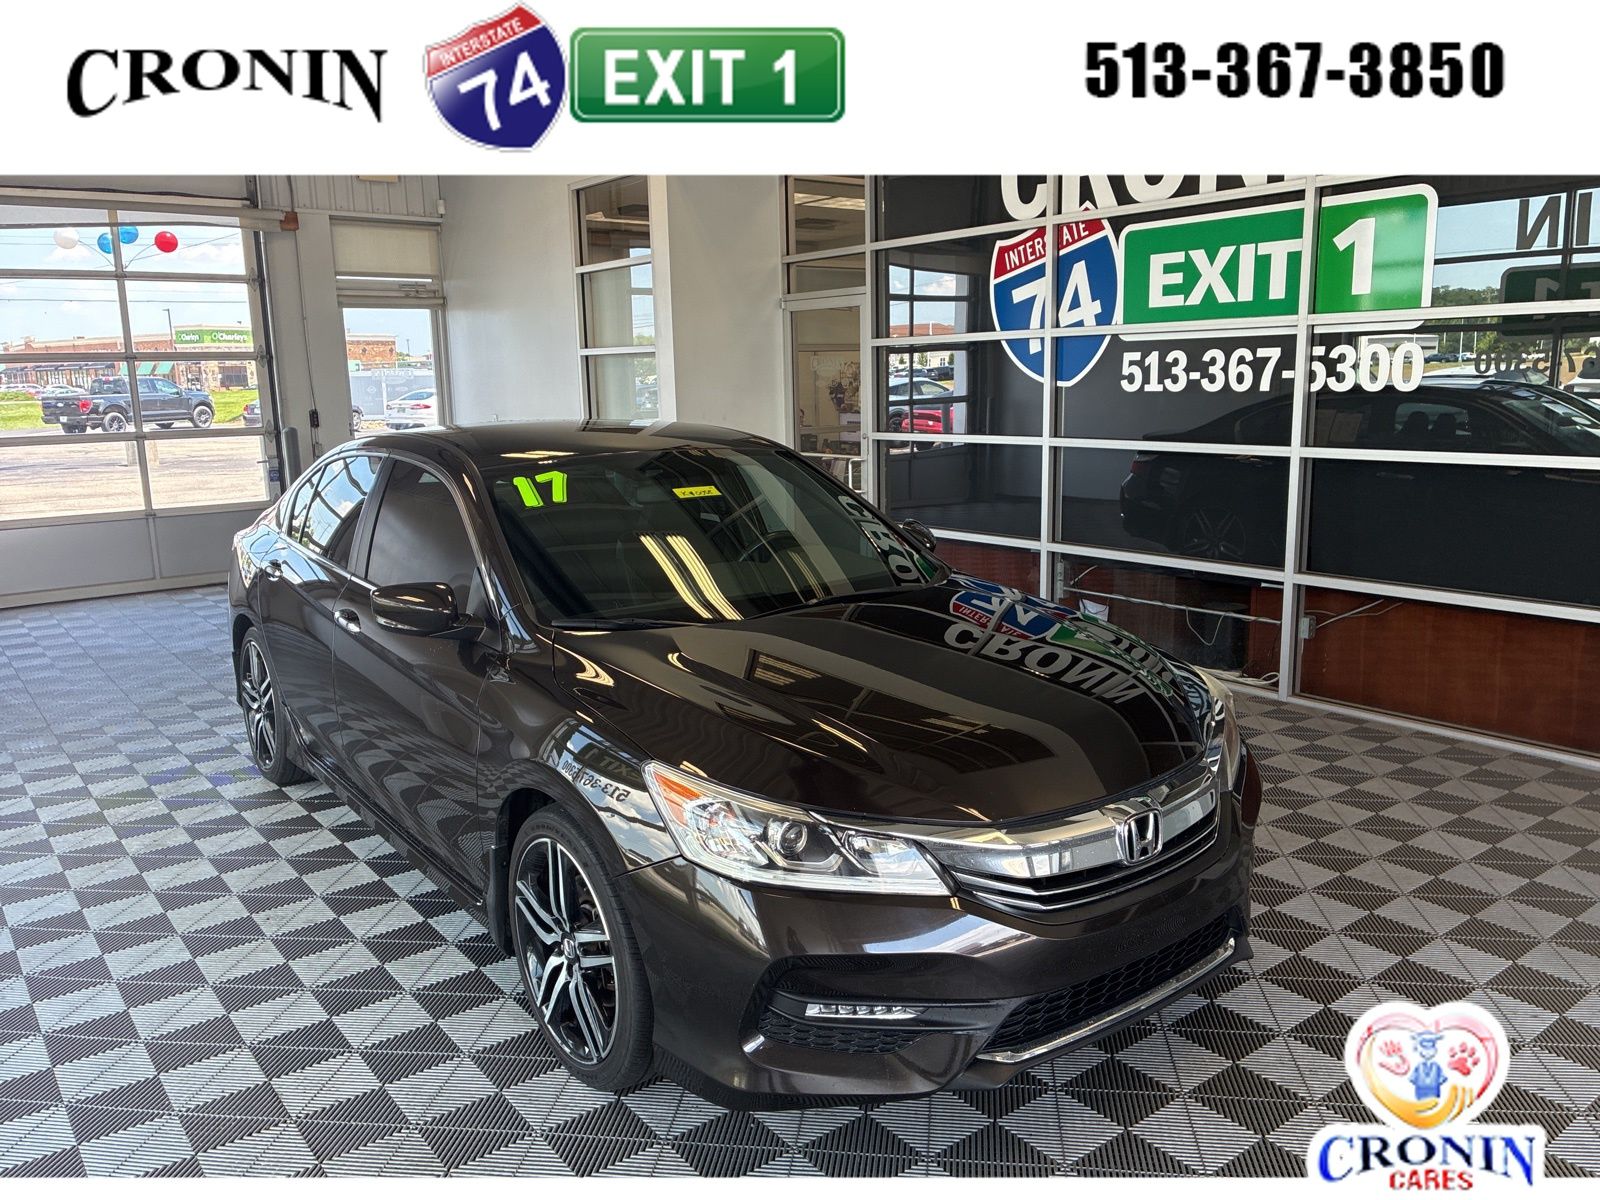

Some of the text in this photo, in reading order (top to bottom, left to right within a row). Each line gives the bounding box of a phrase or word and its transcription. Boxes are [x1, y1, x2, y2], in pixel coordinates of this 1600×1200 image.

[1005, 221, 1090, 271] INTERATE
[1149, 217, 1376, 308] EXIT 1
[1011, 260, 1102, 355] 74
[1120, 342, 1425, 392] 513-367-5300
[513, 471, 567, 507] 17
